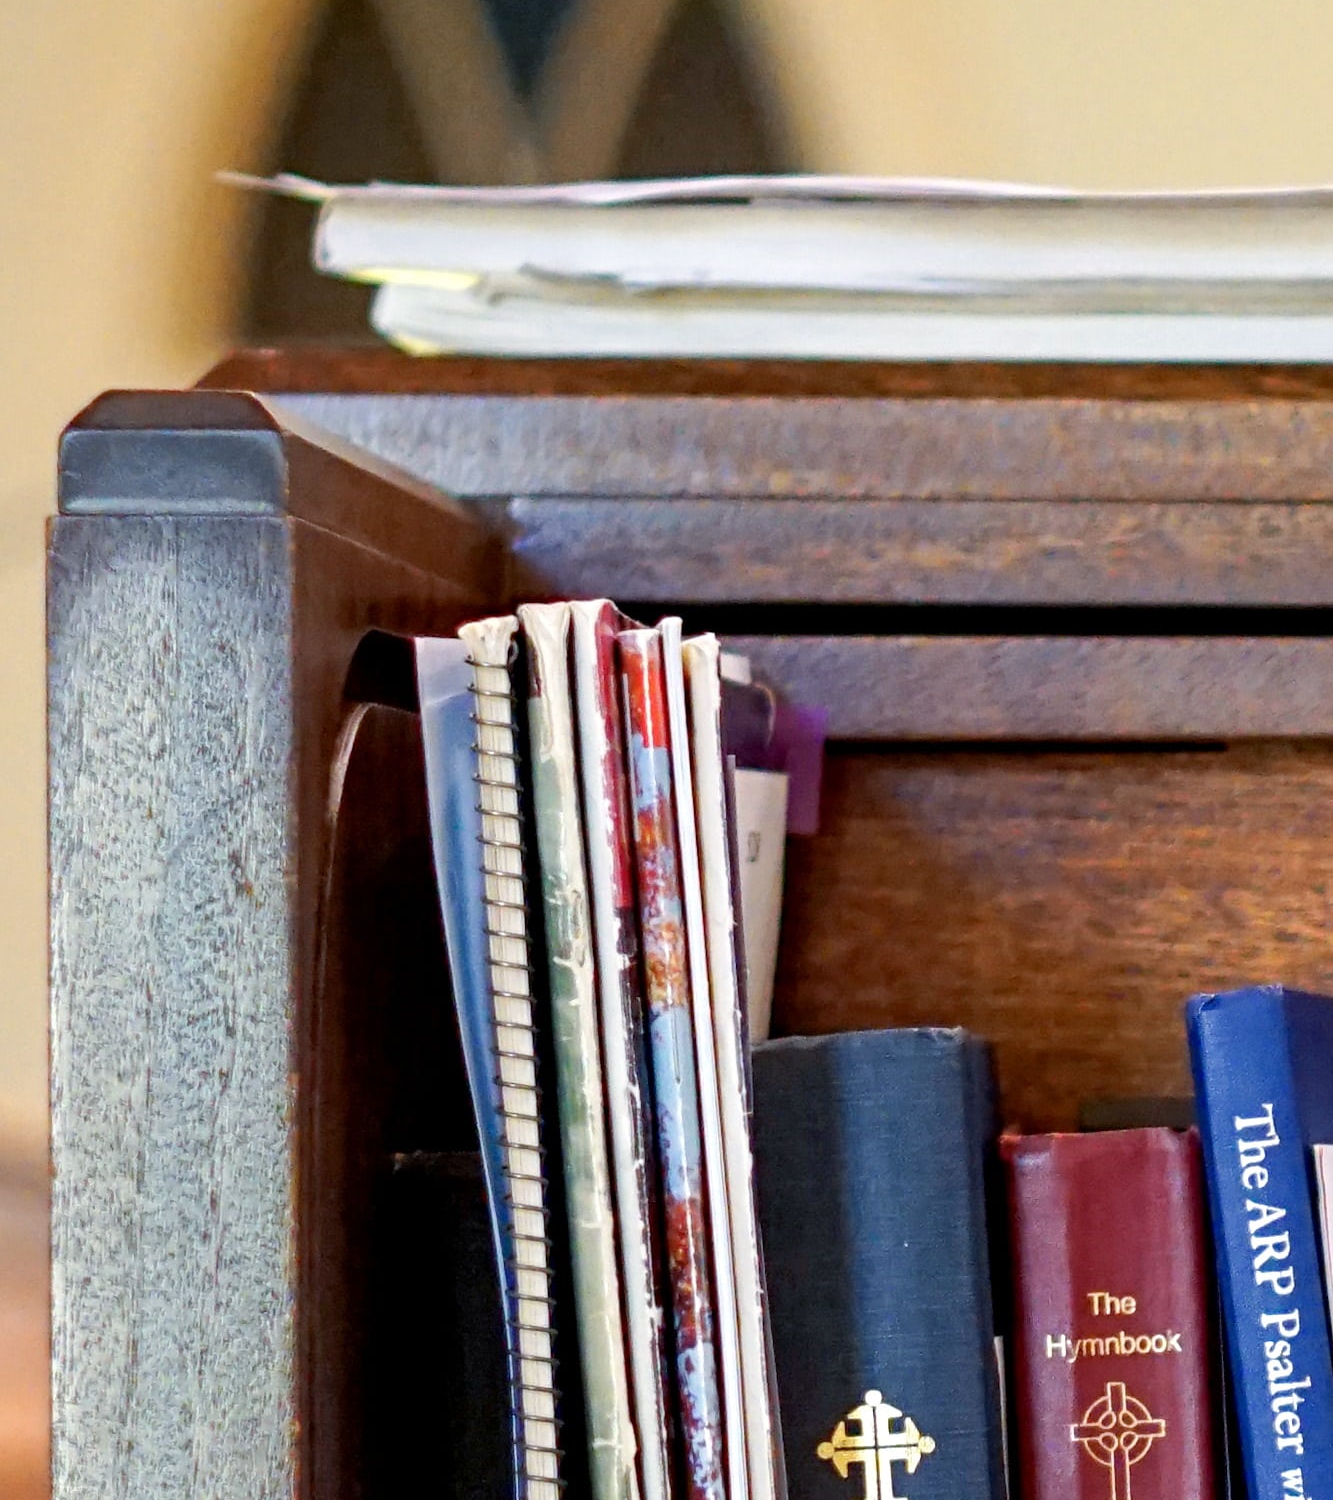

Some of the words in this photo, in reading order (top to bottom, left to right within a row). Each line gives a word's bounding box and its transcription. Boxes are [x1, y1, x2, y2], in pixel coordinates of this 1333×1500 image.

[1233, 1102, 1281, 1189] The
[1246, 1199, 1295, 1296] ARP
[1045, 1329, 1183, 1364] Hymnbook
[1087, 1291, 1137, 1316] The
[1260, 1308, 1312, 1455] Psalter
